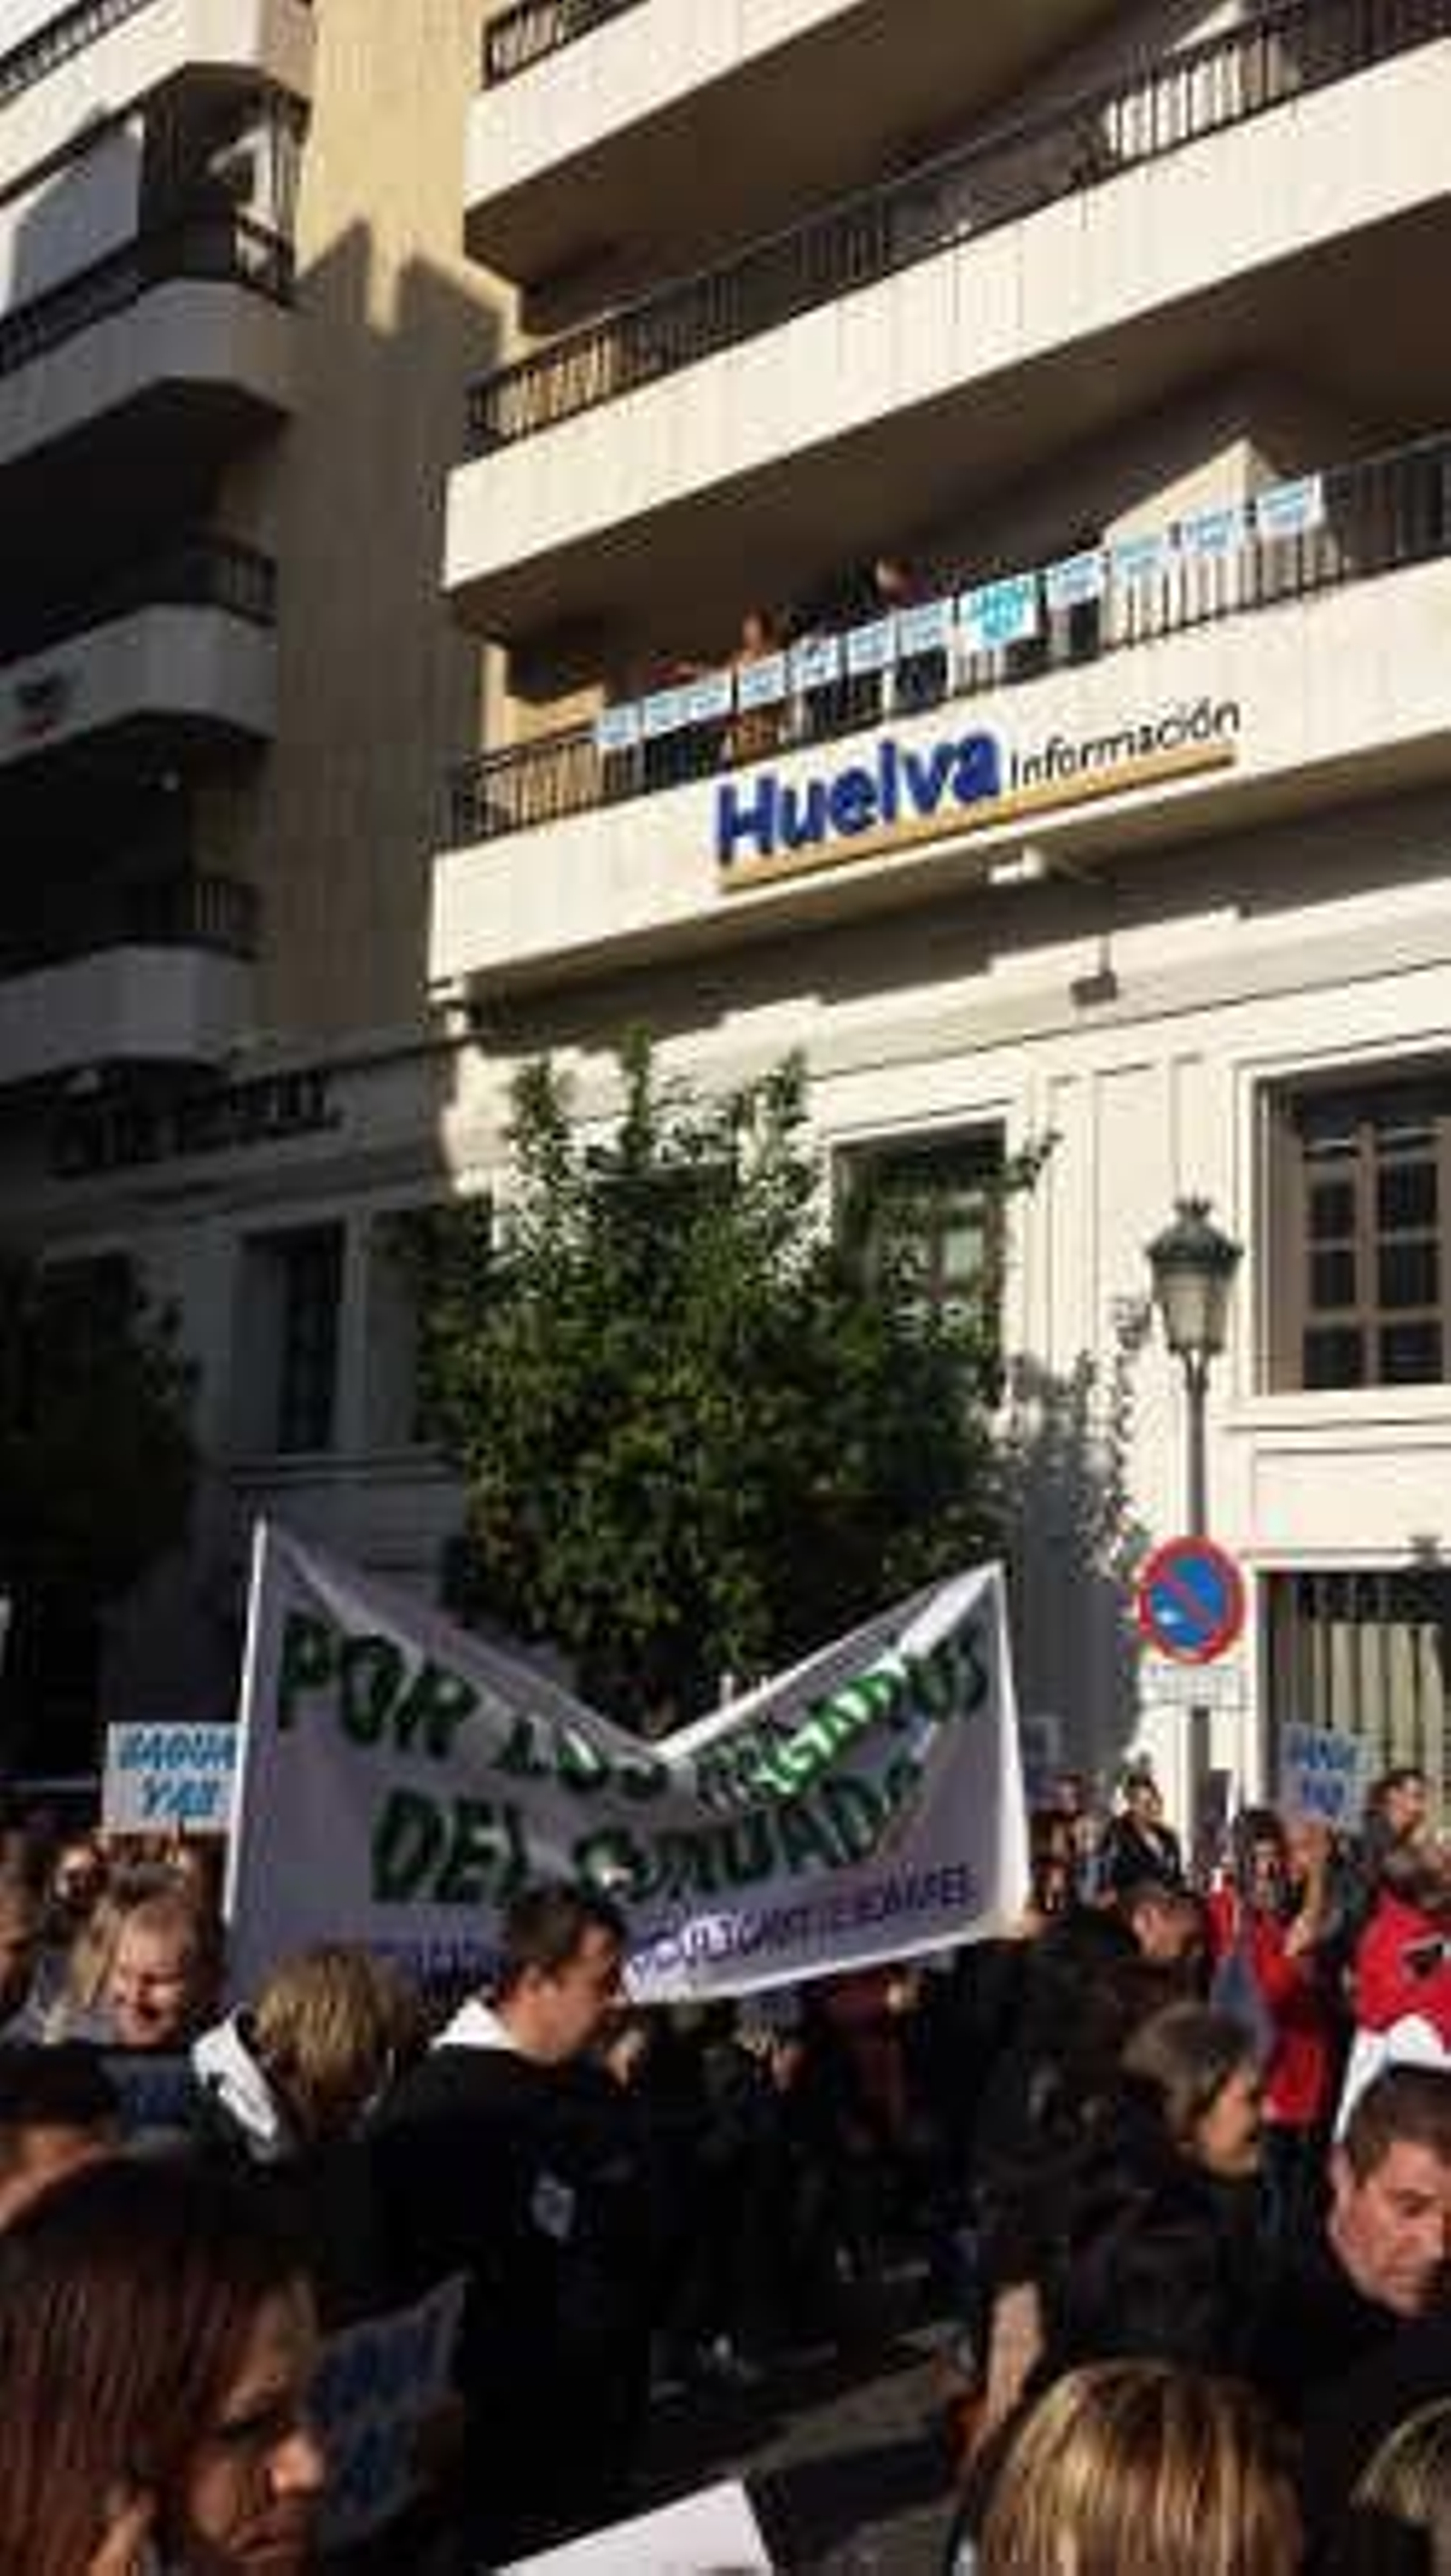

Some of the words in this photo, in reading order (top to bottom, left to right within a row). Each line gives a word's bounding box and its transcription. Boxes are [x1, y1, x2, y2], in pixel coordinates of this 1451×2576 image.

[715, 729, 1000, 865] Huelva
[1010, 698, 1242, 790] Información
[277, 1611, 482, 1761] POR
[370, 1787, 530, 1905] DEL
